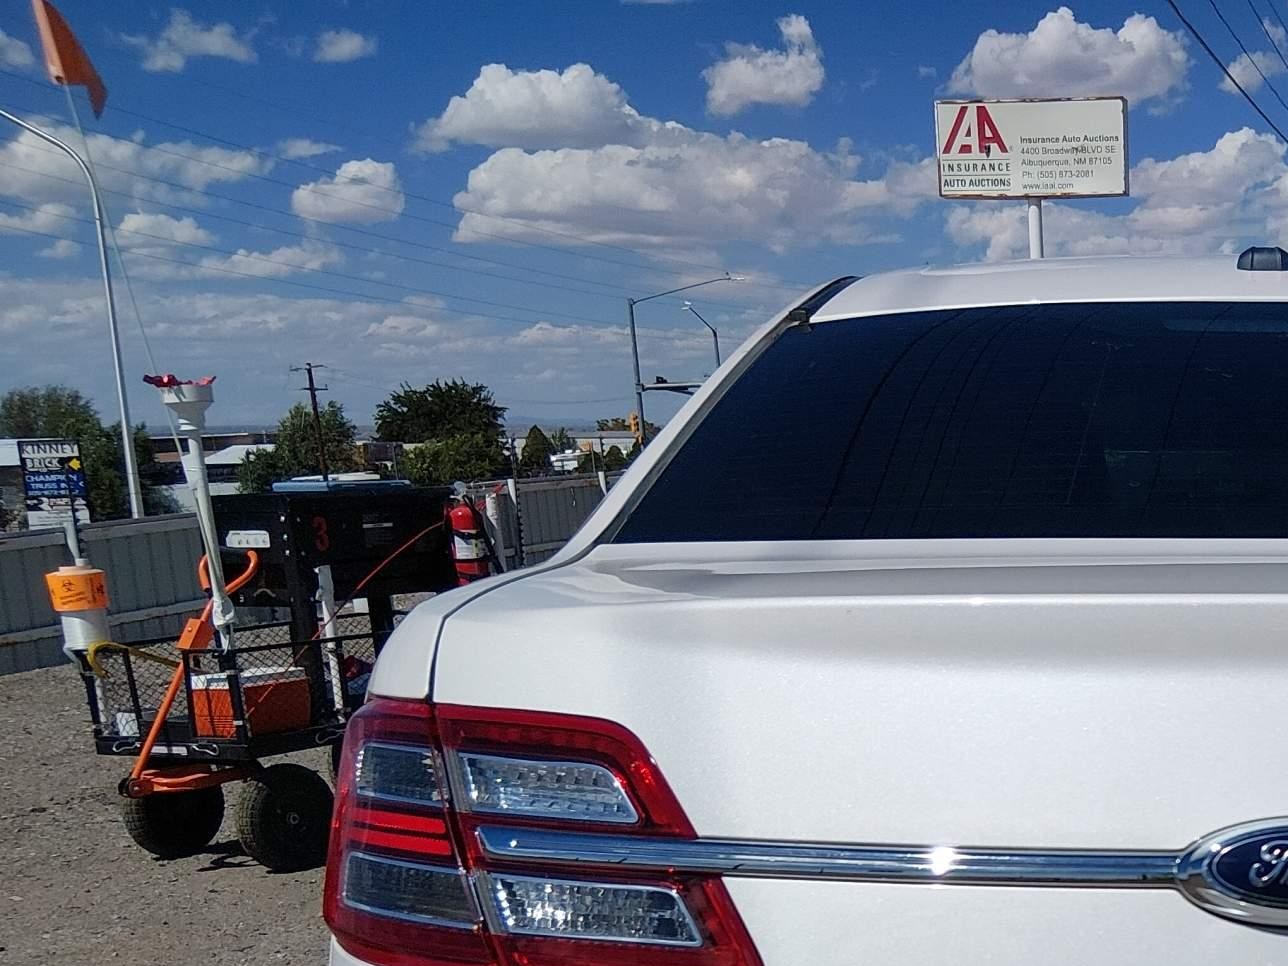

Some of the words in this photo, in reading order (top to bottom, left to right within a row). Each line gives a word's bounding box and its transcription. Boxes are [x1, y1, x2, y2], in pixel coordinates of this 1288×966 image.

[1020, 135, 1060, 144] Insurance
[1062, 135, 1081, 143] Auto
[1082, 134, 1119, 142] Auctions
[1020, 147, 1040, 155] 4400
[1041, 147, 1078, 156] Broadway
[1080, 145, 1103, 154] BLVD
[1104, 145, 1117, 153] SE
[1073, 158, 1087, 166] NM
[1088, 157, 1113, 165] 87105
[942, 162, 1011, 173] INSURANCE
[1037, 170, 1057, 180] (505)
[943, 178, 967, 188] AUTO
[968, 178, 1012, 188] AUCTIONS
[1021, 182, 1074, 190] www.iaai.com
[22, 443, 77, 455] KINNEY
[25, 457, 61, 469] BRICK
